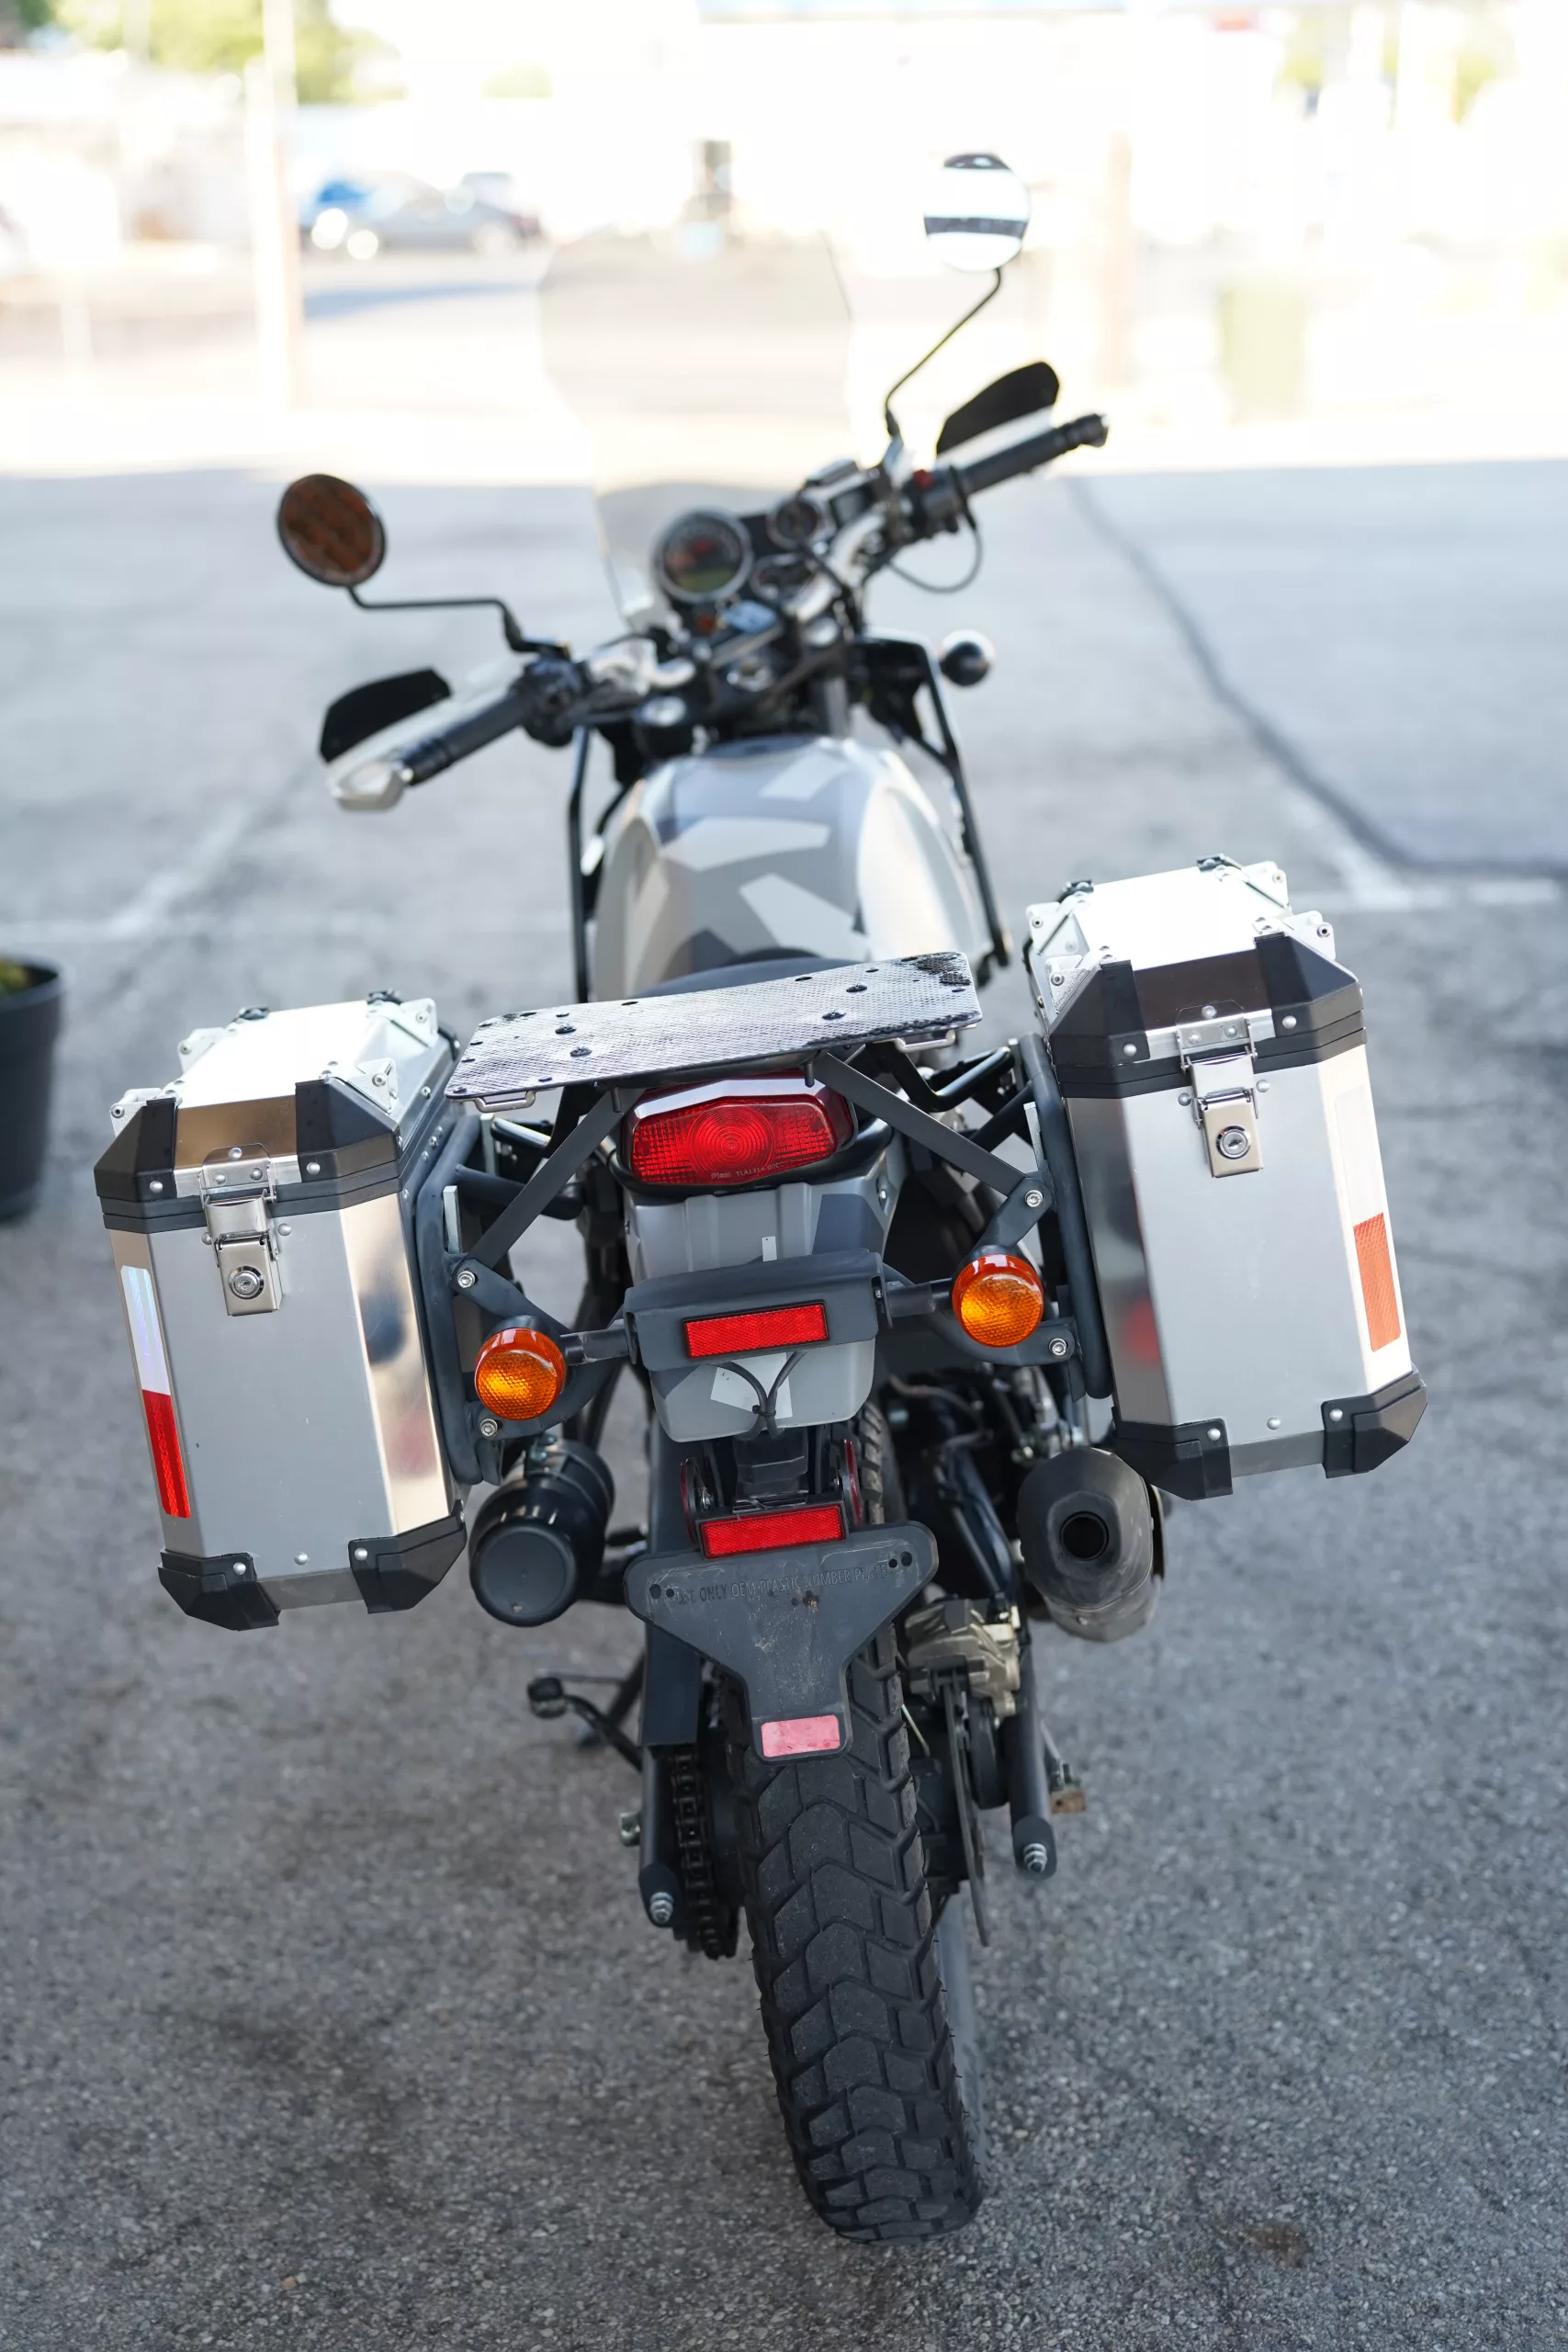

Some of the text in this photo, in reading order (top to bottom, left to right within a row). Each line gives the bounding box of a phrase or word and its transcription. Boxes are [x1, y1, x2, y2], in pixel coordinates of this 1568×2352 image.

[677, 1564, 887, 1605] USE ONLY OEM PLASTIC NUMBER PLATE
